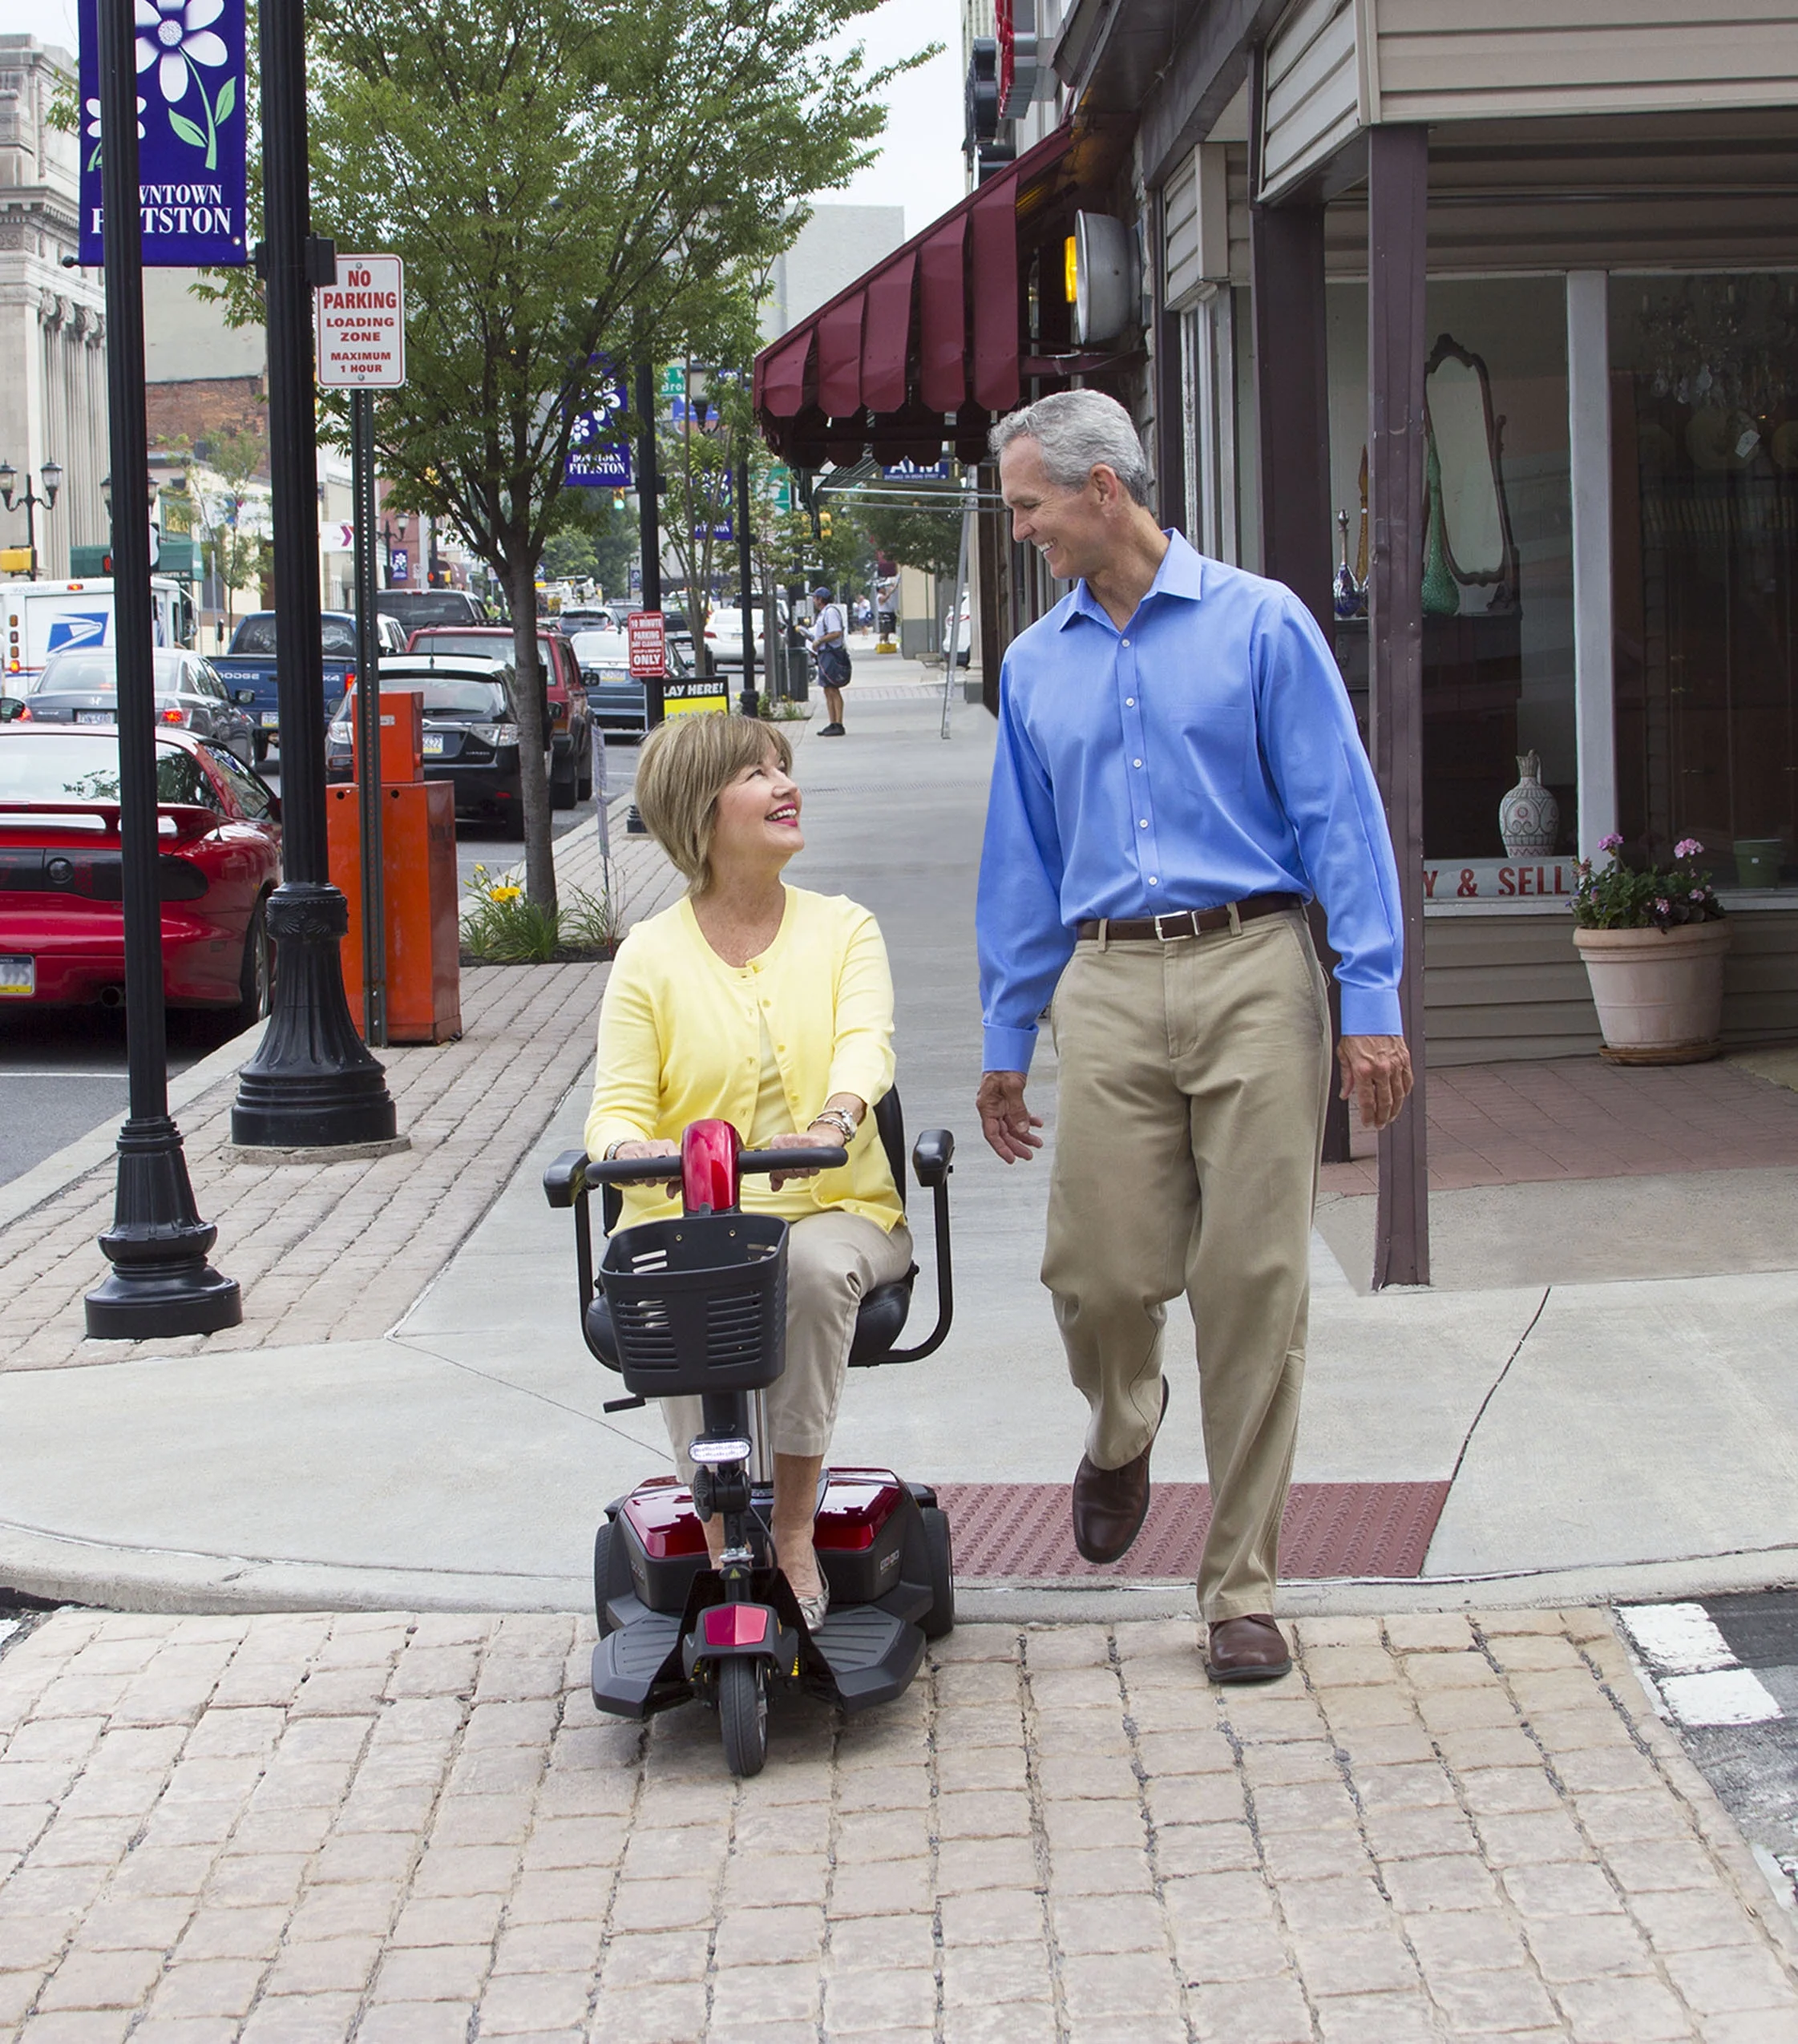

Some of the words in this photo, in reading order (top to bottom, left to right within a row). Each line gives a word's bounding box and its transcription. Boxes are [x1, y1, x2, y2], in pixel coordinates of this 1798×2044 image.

[139, 184, 222, 204] WNTOWN
[91, 207, 232, 234] PTSTON
[348, 270, 371, 287] NO
[323, 292, 397, 309] PARKING
[326, 317, 394, 327] LOADING
[341, 332, 381, 341] ZONE
[330, 352, 391, 361] MAXIMUM
[341, 365, 345, 373] 1
[350, 365, 382, 373] HOUR
[572, 454, 622, 463] DOWTOWN
[569, 462, 625, 475] PITSTON
[633, 654, 661, 665] ONLY
[663, 685, 685, 697] LAY
[687, 682, 724, 696] HERE!
[1424, 871, 1438, 898] Y
[1457, 868, 1478, 897] &
[1498, 866, 1570, 896] SELL
